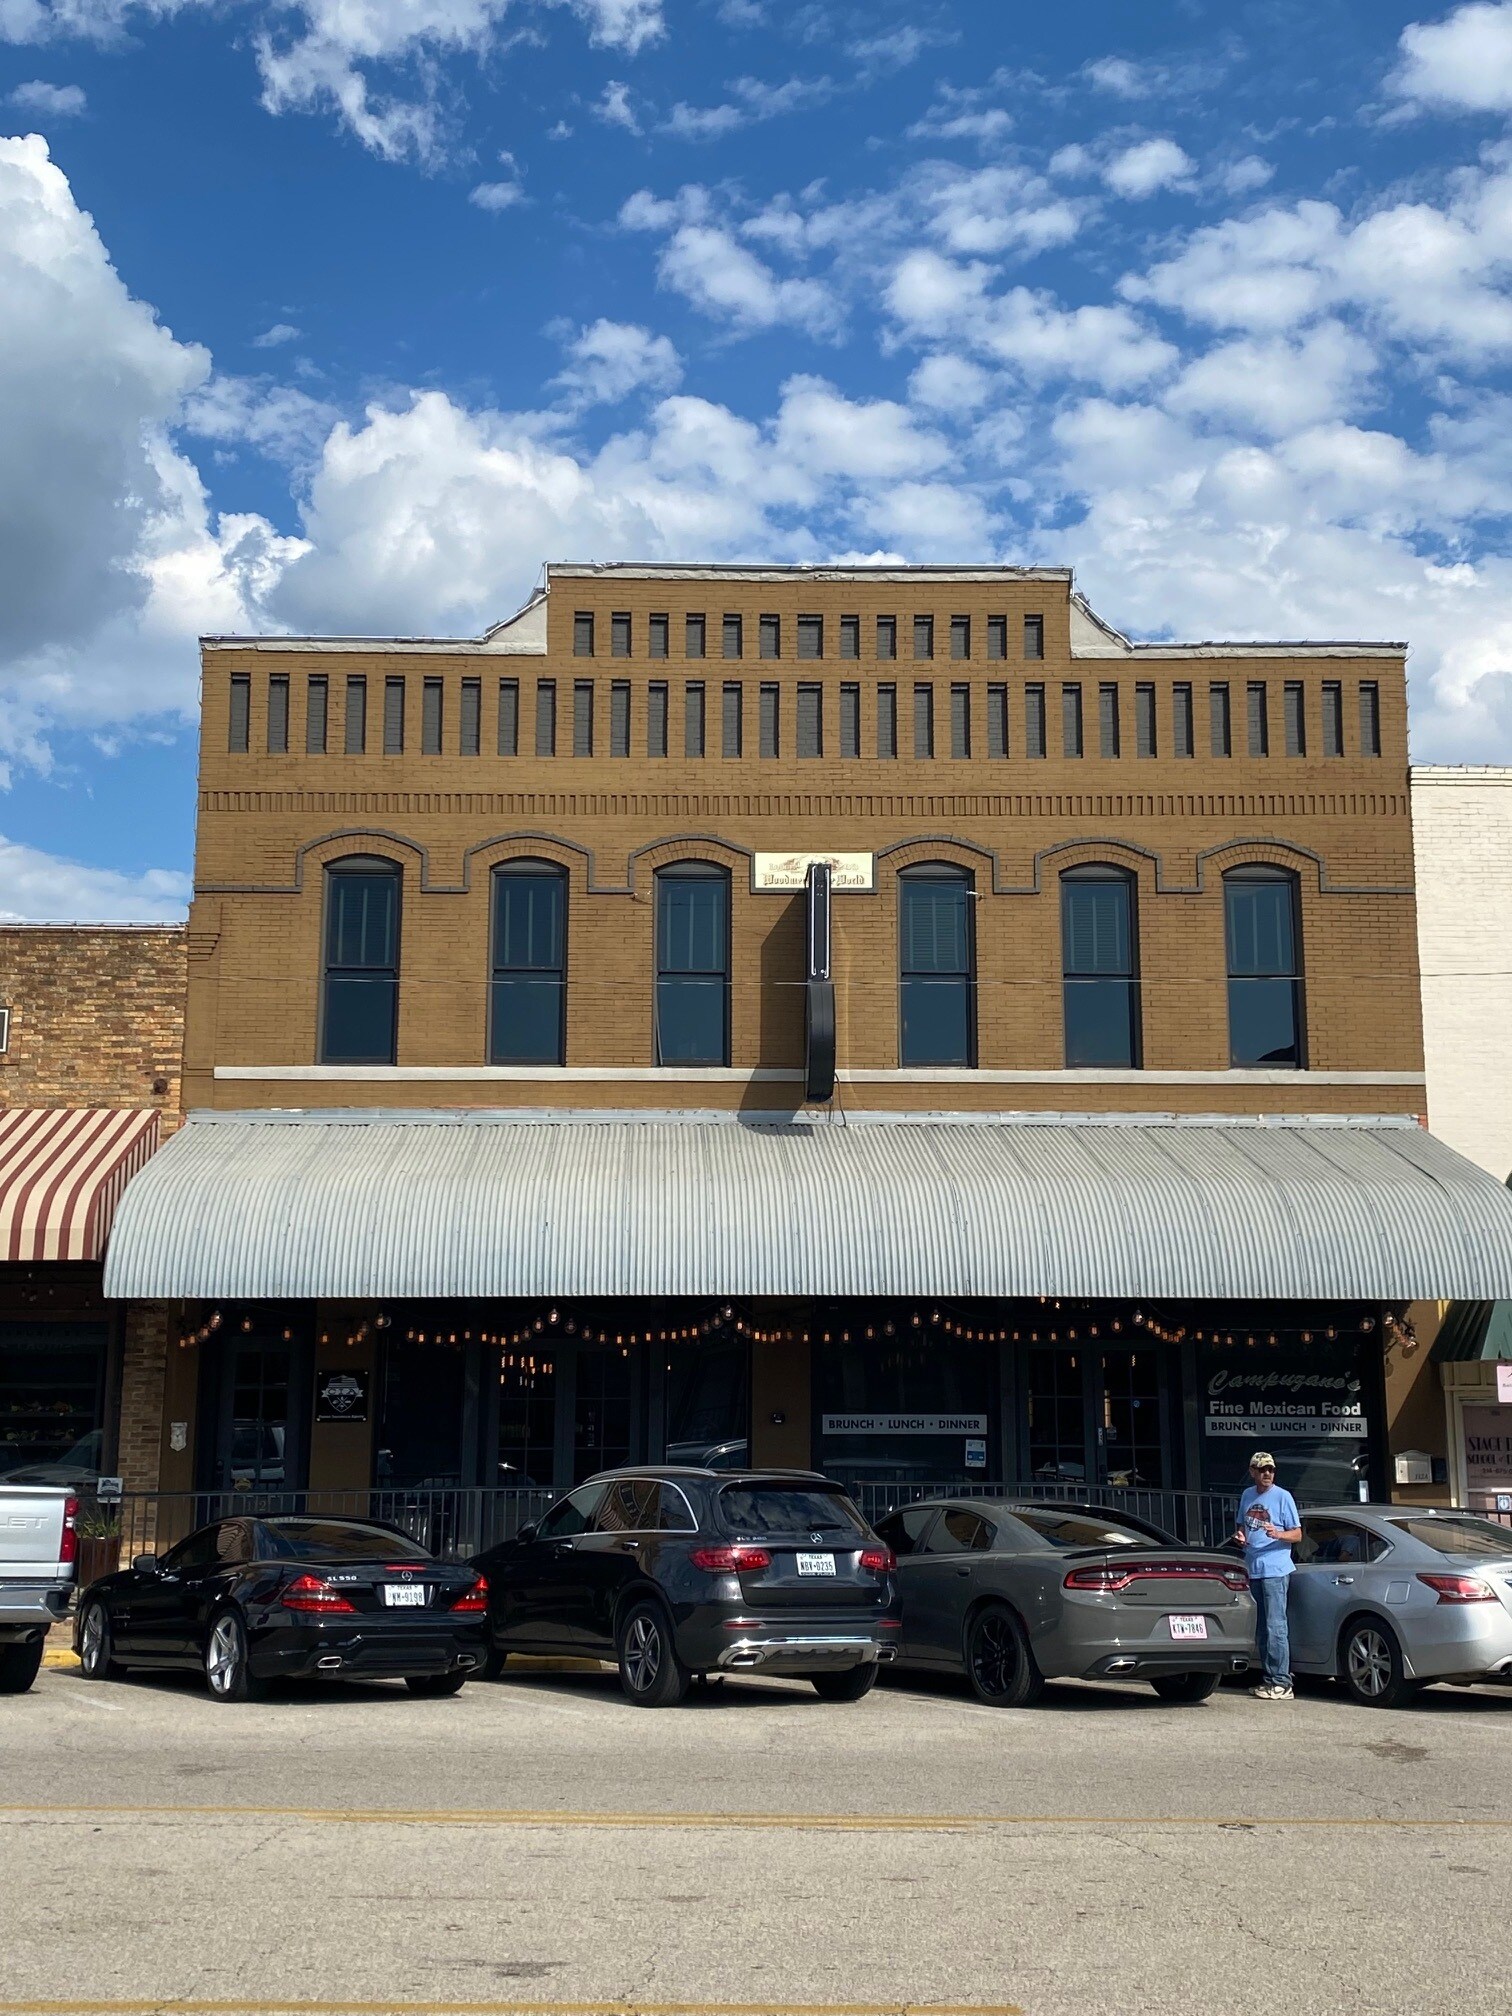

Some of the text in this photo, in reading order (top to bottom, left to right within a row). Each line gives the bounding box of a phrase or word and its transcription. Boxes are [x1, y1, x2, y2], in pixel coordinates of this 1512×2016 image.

[836, 874, 865, 886] World
[1208, 1370, 1361, 1395] Campuzano's
[1209, 1401, 1362, 1416] Fine Mexican Food
[828, 1419, 980, 1429] BRUNCH LUNCH DINNER
[1211, 1421, 1362, 1432] BRUNCH LUNCH DINNER
